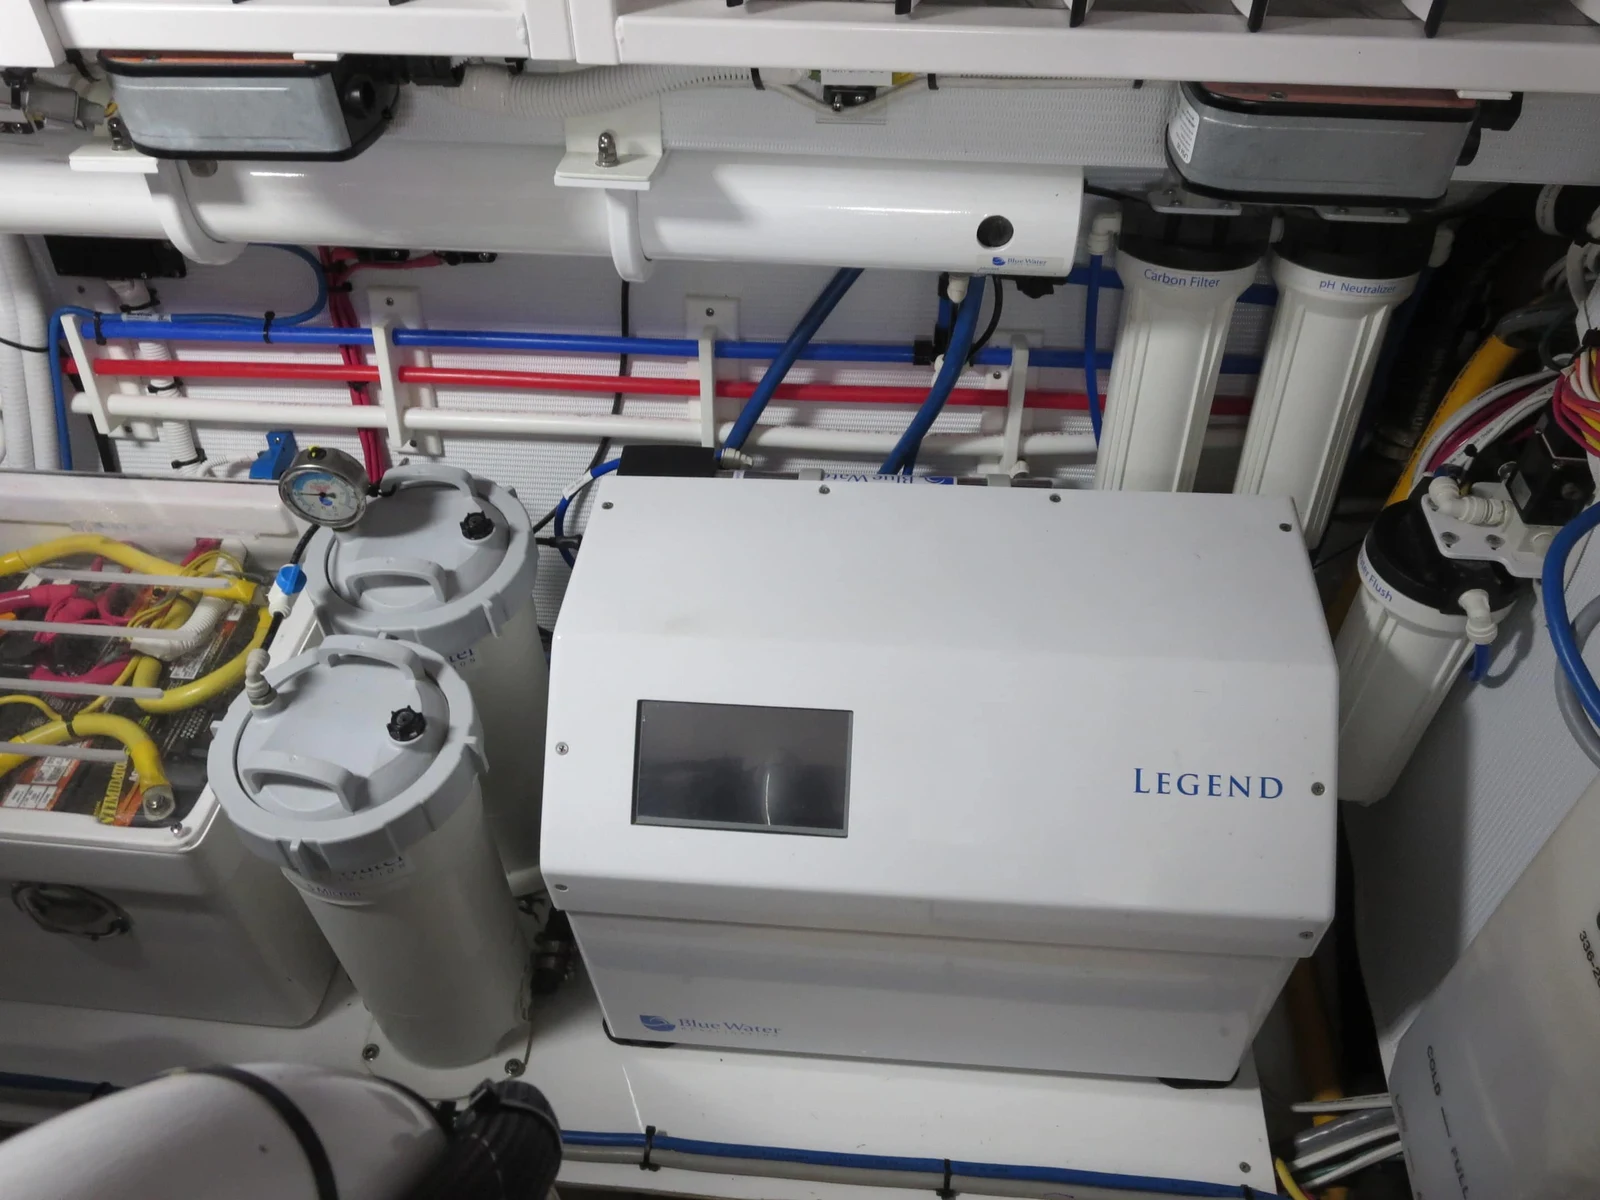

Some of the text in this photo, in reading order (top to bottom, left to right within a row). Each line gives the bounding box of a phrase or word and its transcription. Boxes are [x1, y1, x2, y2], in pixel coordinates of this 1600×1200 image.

[1007, 257, 1048, 266] Blue Water
[1144, 268, 1221, 288] Carbon Filter
[1319, 280, 1397, 294] pH Neutralizer
[1369, 574, 1393, 602] Flush
[1133, 767, 1284, 800] LEGEND
[678, 1018, 782, 1035] Blue Water
[1427, 1045, 1469, 1200] COLD FULL
